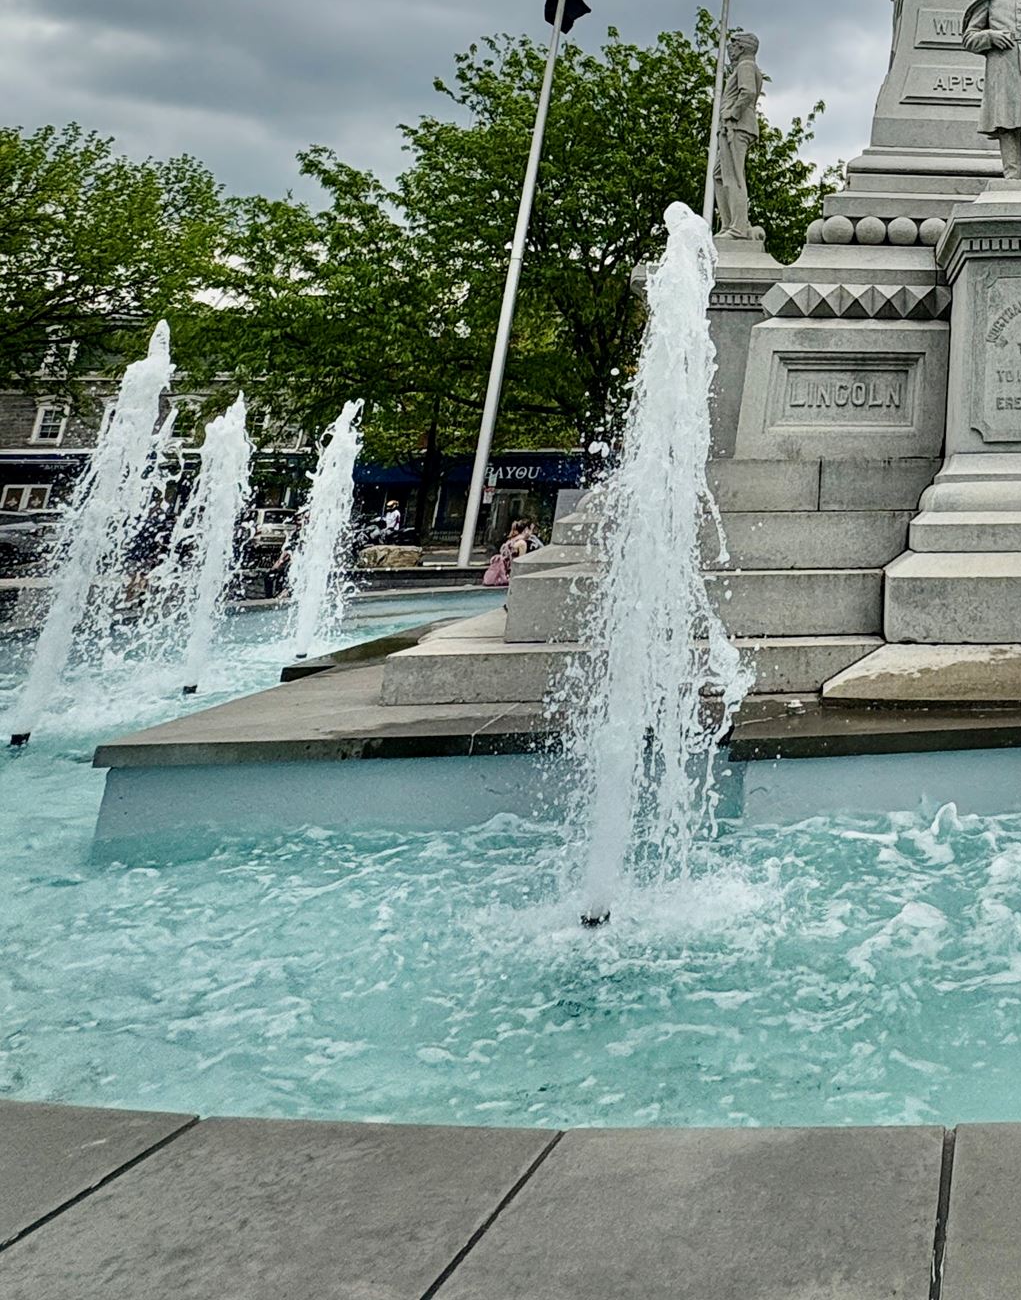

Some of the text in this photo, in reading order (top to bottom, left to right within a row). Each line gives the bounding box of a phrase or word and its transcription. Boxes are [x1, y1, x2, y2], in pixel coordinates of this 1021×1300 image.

[996, 369, 1014, 383] TO
[789, 381, 901, 408] LINCOLN
[485, 466, 541, 479] BAYOU
